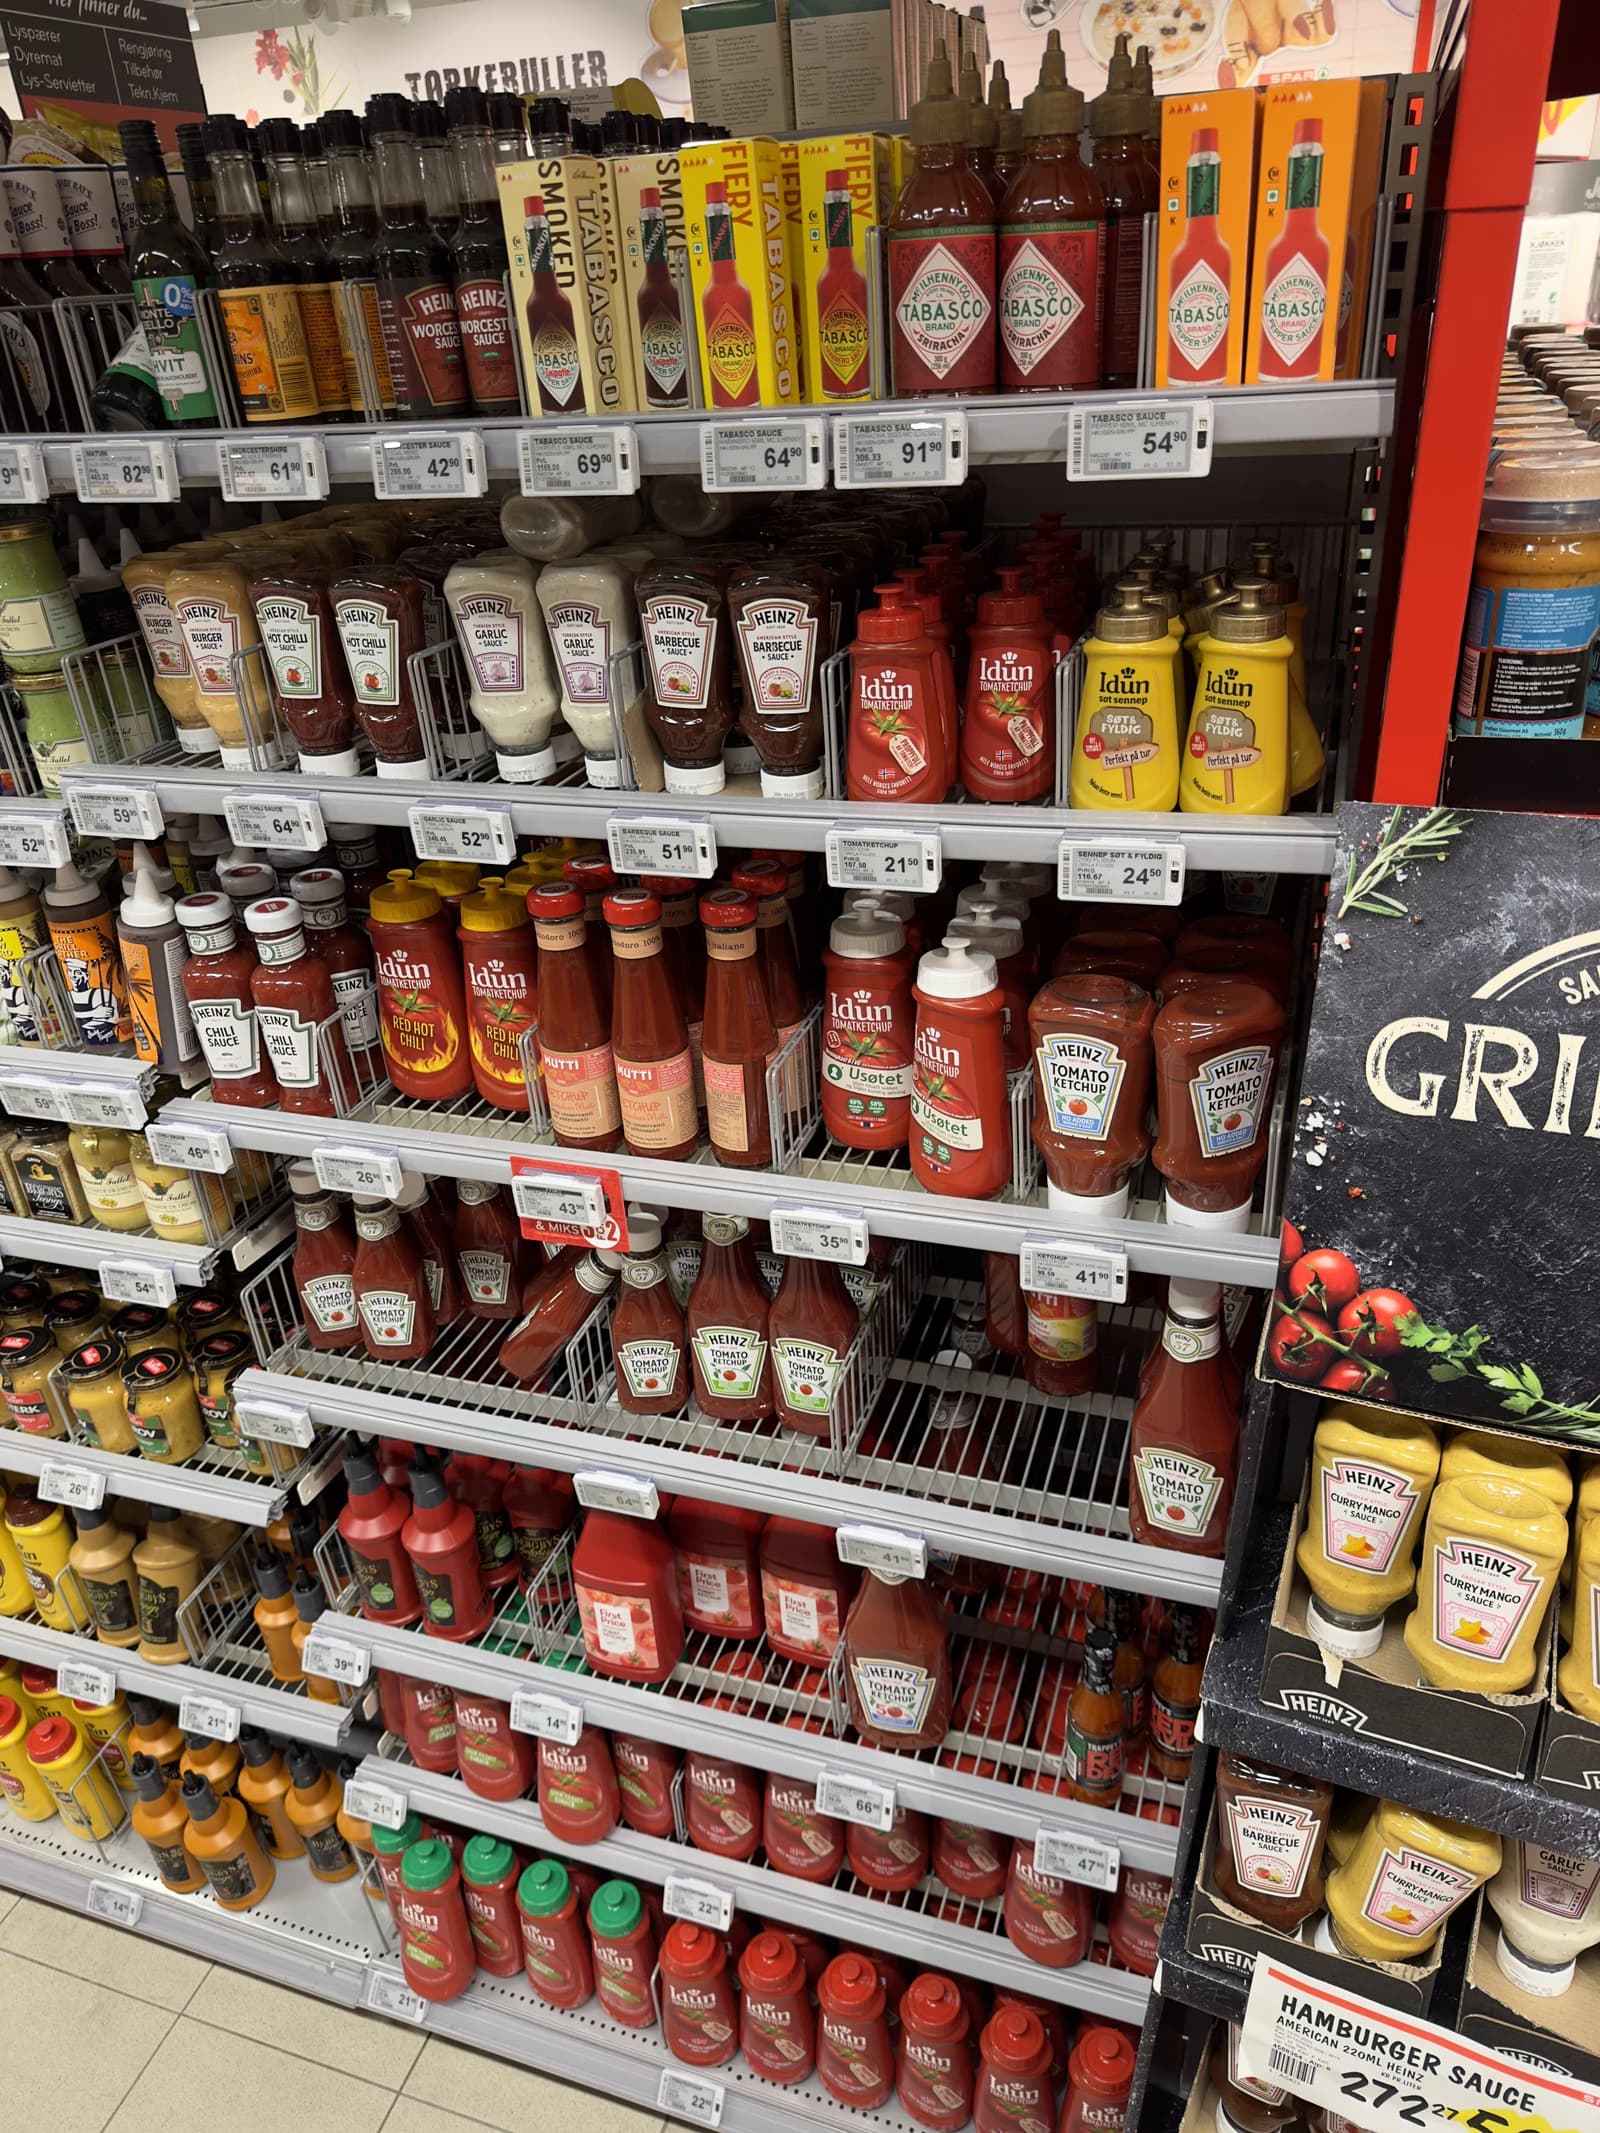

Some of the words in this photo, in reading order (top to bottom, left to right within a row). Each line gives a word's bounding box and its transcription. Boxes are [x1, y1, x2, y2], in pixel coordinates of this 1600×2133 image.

[7, 20, 62, 44] Lyspærer
[13, 46, 63, 68] Dyremat
[118, 38, 172, 63] Rengjøring
[122, 60, 164, 81] Tilbehør
[1271, 69, 1315, 83] SPAR
[19, 70, 97, 96] Lys-Servietter
[720, 145, 754, 228] FIERY
[843, 136, 873, 222] FIERY
[902, 299, 984, 323] TABASCO
[1001, 296, 1073, 318] TABASCO
[1169, 303, 1230, 323] TABASCO
[1263, 297, 1327, 319] TABASCO
[925, 322, 957, 332] BRAND
[1013, 319, 1042, 329] BRAND
[1186, 325, 1212, 334] BRAND
[1280, 319, 1307, 329] BRAND
[473, 333, 506, 346] SAUCE
[820, 328, 869, 345] TABASCO
[917, 331, 967, 352] SRIRACHA
[1007, 328, 1052, 348] SRIRACHA
[707, 342, 756, 359] TABASCO
[1091, 414, 1135, 424] TABASCO
[1136, 411, 1167, 422] SAUCE
[718, 429, 756, 439] TABASCO
[855, 424, 892, 434] TABASCO
[184, 606, 219, 620] HEINZ
[467, 601, 505, 617] HEINZ
[556, 609, 594, 624] HEINZ
[656, 606, 696, 622] HEINZ
[754, 608, 797, 627] HEINZ
[145, 617, 174, 629] BURGER
[191, 632, 224, 644] BURGER
[267, 633, 284, 644] HOT
[283, 633, 309, 645] CHILLI
[346, 637, 362, 649] HOT
[361, 638, 387, 649] CHILLI
[475, 628, 509, 640] GARLIC
[654, 635, 702, 650] BARBECUE
[563, 638, 595, 650] GARLIC
[752, 639, 803, 654] BARBECUE
[767, 652, 790, 662] SAUCE
[979, 657, 1034, 683] Idun
[859, 674, 914, 700] Idun
[979, 680, 1034, 693] TOMATKETCHUP
[1099, 670, 1151, 695] Idun
[1205, 670, 1254, 698] Idun
[860, 698, 914, 712] TOMATKETCHUP
[1112, 695, 1149, 706] sennep
[1216, 695, 1251, 709] sennep
[1101, 722, 1142, 735] FYLDIG
[1205, 723, 1243, 738] FYLDIG
[1103, 752, 1130, 767] Perfekt
[1129, 752, 1140, 765] på
[1139, 747, 1152, 760] tur
[1206, 755, 1231, 768] Perfekt
[842, 840, 899, 850] TOMATKETCHUP
[1077, 850, 1109, 859] SENNEP
[1134, 853, 1163, 861] FYLDIG
[375, 951, 431, 980] Idun
[379, 976, 432, 990] TOMATKETCHUP
[1558, 966, 1600, 1006] SA
[830, 991, 893, 1022] Idun
[205, 1024, 235, 1039] CHILI
[392, 1015, 412, 1032] RED
[412, 1021, 436, 1039] HOT
[486, 1024, 507, 1043] RED
[831, 1016, 893, 1034] TOMATKETCHUP
[207, 1034, 240, 1049] SAUCE
[399, 1032, 426, 1052] CHILI
[914, 1022, 961, 1068] Idun
[1056, 1042, 1104, 1065] HEINZ
[848, 1066, 904, 1087] Usøtet
[1050, 1060, 1110, 1083] TOMATO
[1214, 1056, 1259, 1081] HEINZ
[1052, 1076, 1108, 1095] KETCHUP
[1204, 1074, 1263, 1101] TOMATO
[1207, 1088, 1260, 1113] KETCHUP
[922, 1103, 969, 1138] Usøtet
[535, 1220, 546, 1232] &
[547, 1222, 580, 1236] MIKS
[368, 1308, 406, 1319] TOMATO
[371, 1315, 405, 1324] KETCHUP
[708, 1333, 749, 1348] HEINZ
[709, 1349, 750, 1361] TOMATO
[712, 1356, 750, 1367] KETCHUP
[1152, 1454, 1200, 1479] HEINZ
[1148, 1471, 1205, 1496] TOMATO
[1344, 1469, 1397, 1495] HEINZ
[1151, 1483, 1204, 1505] KETCHUP
[1329, 1492, 1364, 1513] CURRY
[1362, 1501, 1402, 1521] MANGO
[1349, 1508, 1378, 1526] SAUCE
[1461, 1549, 1518, 1578] HEINZ
[1443, 1572, 1481, 1596] CURRY
[1478, 1584, 1523, 1606] MANGO
[783, 1595, 807, 1609] First
[784, 1603, 811, 1617] Price
[1463, 1592, 1496, 1610] SAUCE
[600, 1608, 622, 1620] First
[600, 1616, 627, 1629] Price
[869, 1666, 915, 1684] HEINZ
[868, 1680, 917, 1696] TOMATO
[870, 1689, 916, 1704] KETCHUP
[1289, 1694, 1359, 1728] HEINZ
[1248, 1806, 1298, 1827] HEINZ
[1242, 1826, 1301, 1849] BARBECUE
[1256, 1842, 1285, 1854] SAUCE
[1538, 1849, 1587, 1873] GARLIC
[1545, 1861, 1577, 1878] SAUCE
[1409, 1858, 1461, 1887] HEINZ
[1385, 1869, 1419, 1894] CURRY
[1416, 1884, 1455, 1904] MANGO
[1401, 1888, 1431, 1906] SAUCE
[1210, 1947, 1256, 1973] HEIN
[1276, 2015, 1340, 2051] AMERICAN
[1342, 2044, 1384, 2070] 220ML
[1386, 2061, 1425, 2083] HEINZ
[1280, 1993, 1443, 2078] HAMBURGER
[1447, 2065, 1537, 2113] SAUCE
